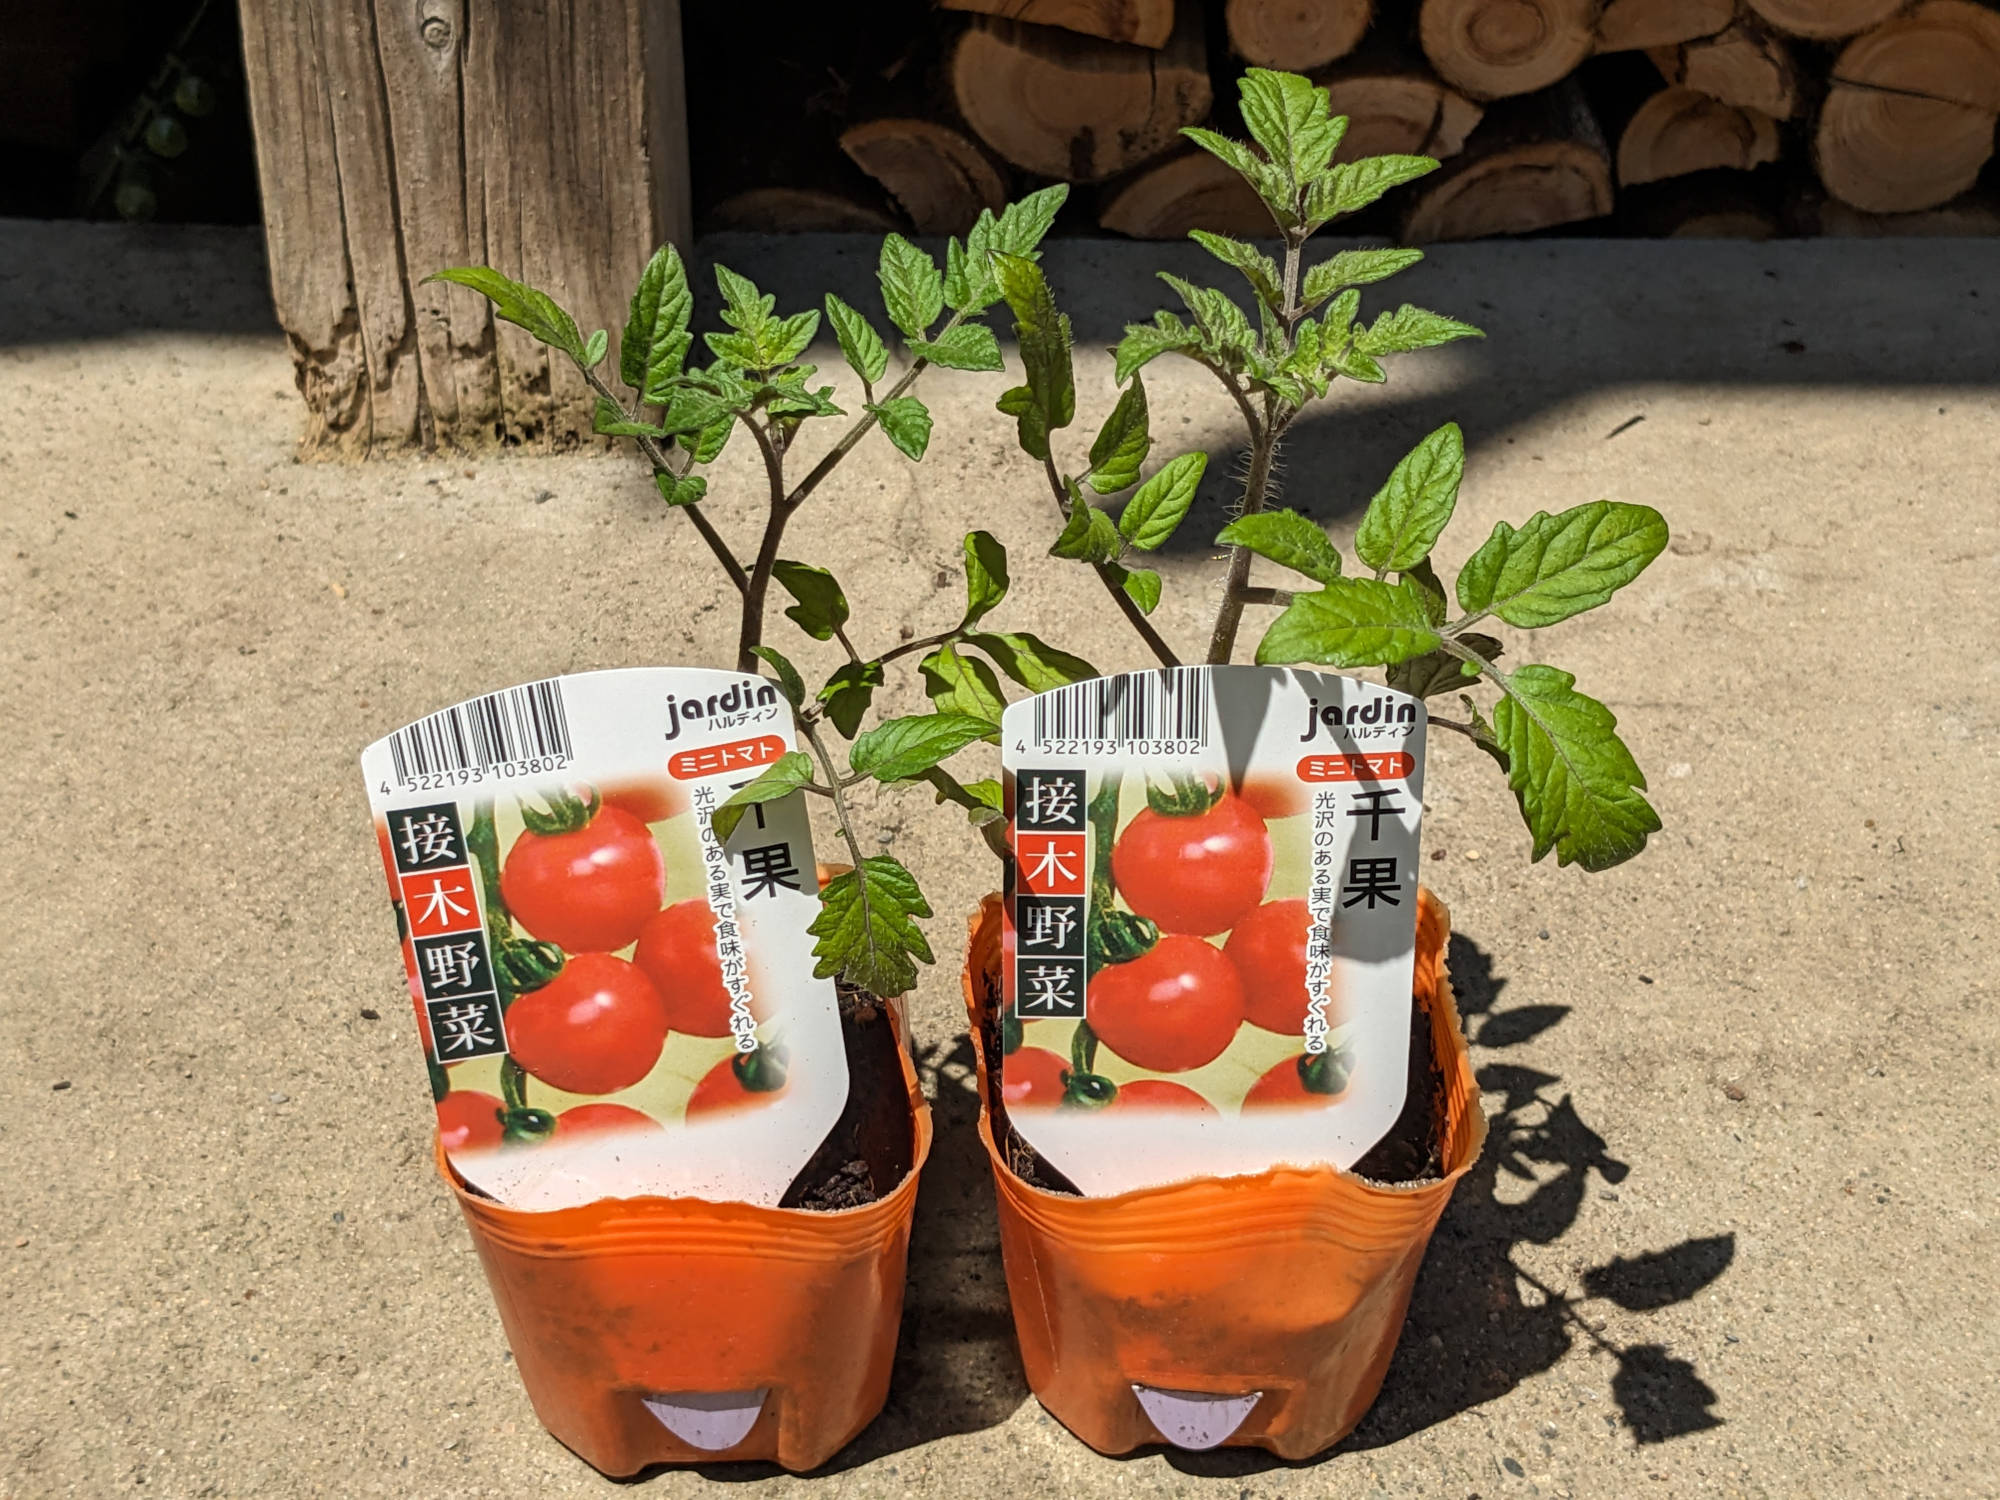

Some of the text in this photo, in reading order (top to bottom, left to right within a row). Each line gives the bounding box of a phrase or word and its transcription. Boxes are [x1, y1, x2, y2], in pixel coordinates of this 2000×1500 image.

[665, 680, 777, 740] jardin
[708, 708, 778, 731] ハルディン
[1300, 695, 1416, 742] jardin
[1015, 739, 1200, 755] 4 522193 103802
[1344, 725, 1415, 739] ハルディン
[380, 755, 568, 795] 4 522193 103802
[680, 742, 774, 772] ミニトマト
[1309, 756, 1402, 776] ミニトマト
[1342, 787, 1406, 909] 千果
[1025, 776, 1077, 1010] 接木野菜
[398, 813, 496, 1053] 接木野菜
[1306, 791, 1336, 1051] 光沢のある実で食味がすぐれる
